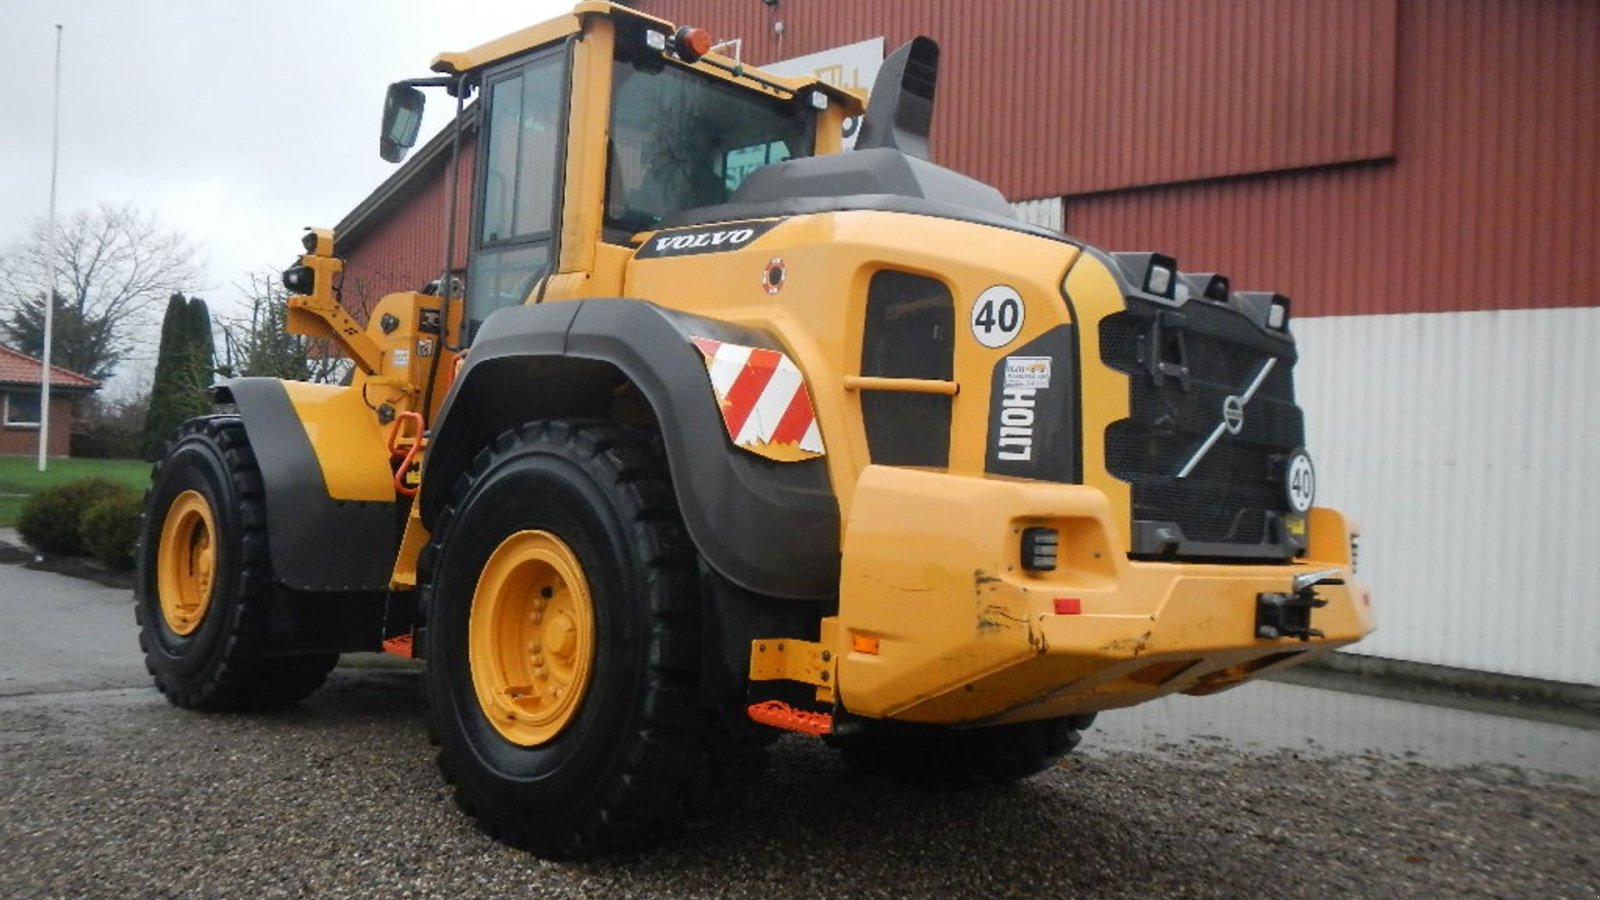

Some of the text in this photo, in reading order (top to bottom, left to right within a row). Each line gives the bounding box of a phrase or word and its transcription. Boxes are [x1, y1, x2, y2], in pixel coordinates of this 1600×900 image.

[656, 228, 754, 251] VOLVO
[974, 298, 1019, 333] 40
[998, 388, 1037, 461] L110H
[1292, 467, 1310, 499] 40
